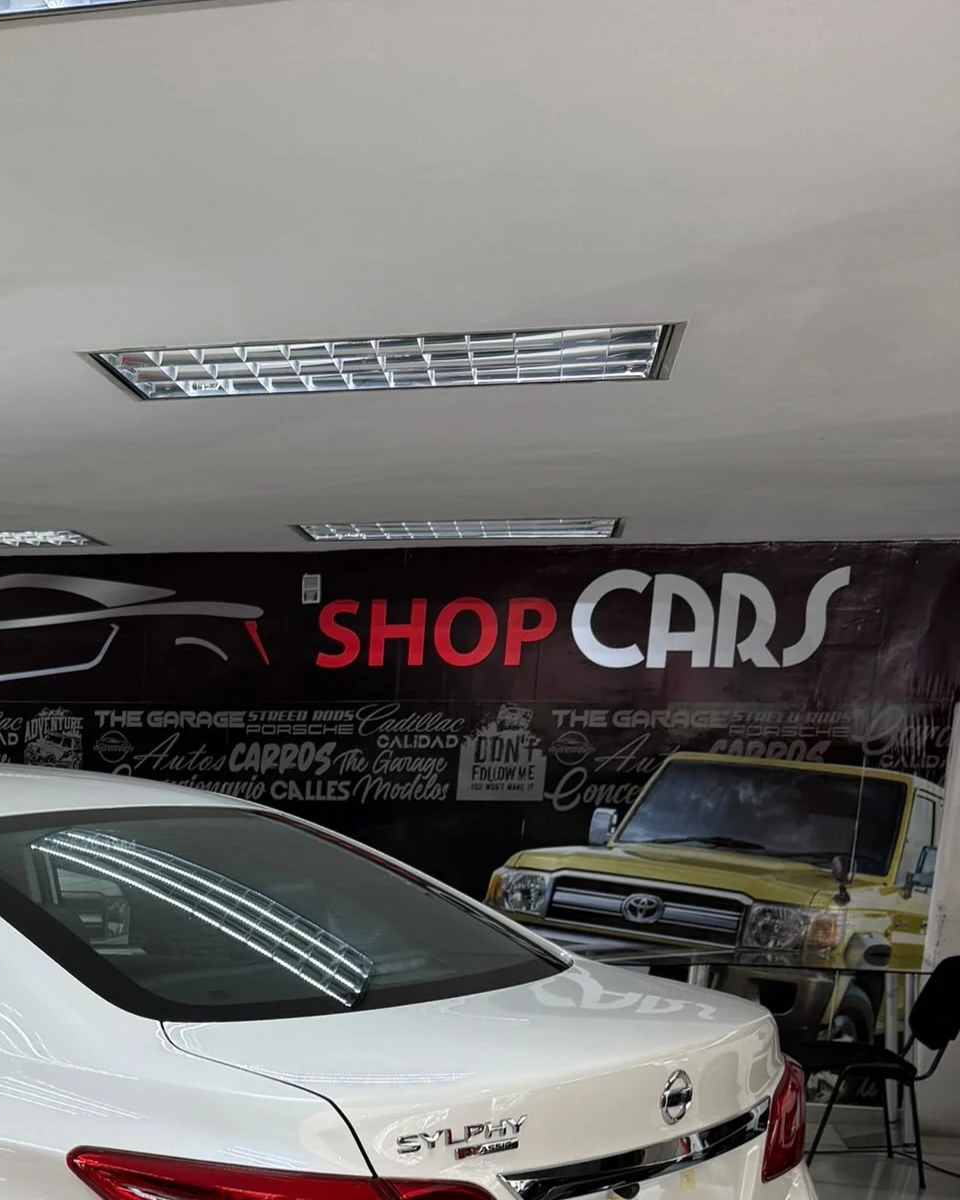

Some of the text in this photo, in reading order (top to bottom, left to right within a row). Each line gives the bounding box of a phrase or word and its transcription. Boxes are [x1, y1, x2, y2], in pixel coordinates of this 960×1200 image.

[315, 566, 850, 668] SHOP CARS
[94, 710, 247, 729] THE GARAGE
[247, 710, 355, 722] STREED RODS
[355, 703, 465, 736] Cadillac
[552, 709, 729, 729] THE GARAGE
[24, 717, 83, 743] ADVENTURE
[246, 724, 354, 735] PORSCHE
[728, 724, 849, 737] PORSCHE
[133, 732, 227, 771] Autos
[229, 741, 337, 775] CARROS
[333, 748, 448, 779] The Garage
[472, 765, 535, 782] FOLLOW ME
[270, 780, 350, 800] CALLES
[353, 772, 450, 804] Modelos
[397, 1114, 528, 1154] SYLPHY
